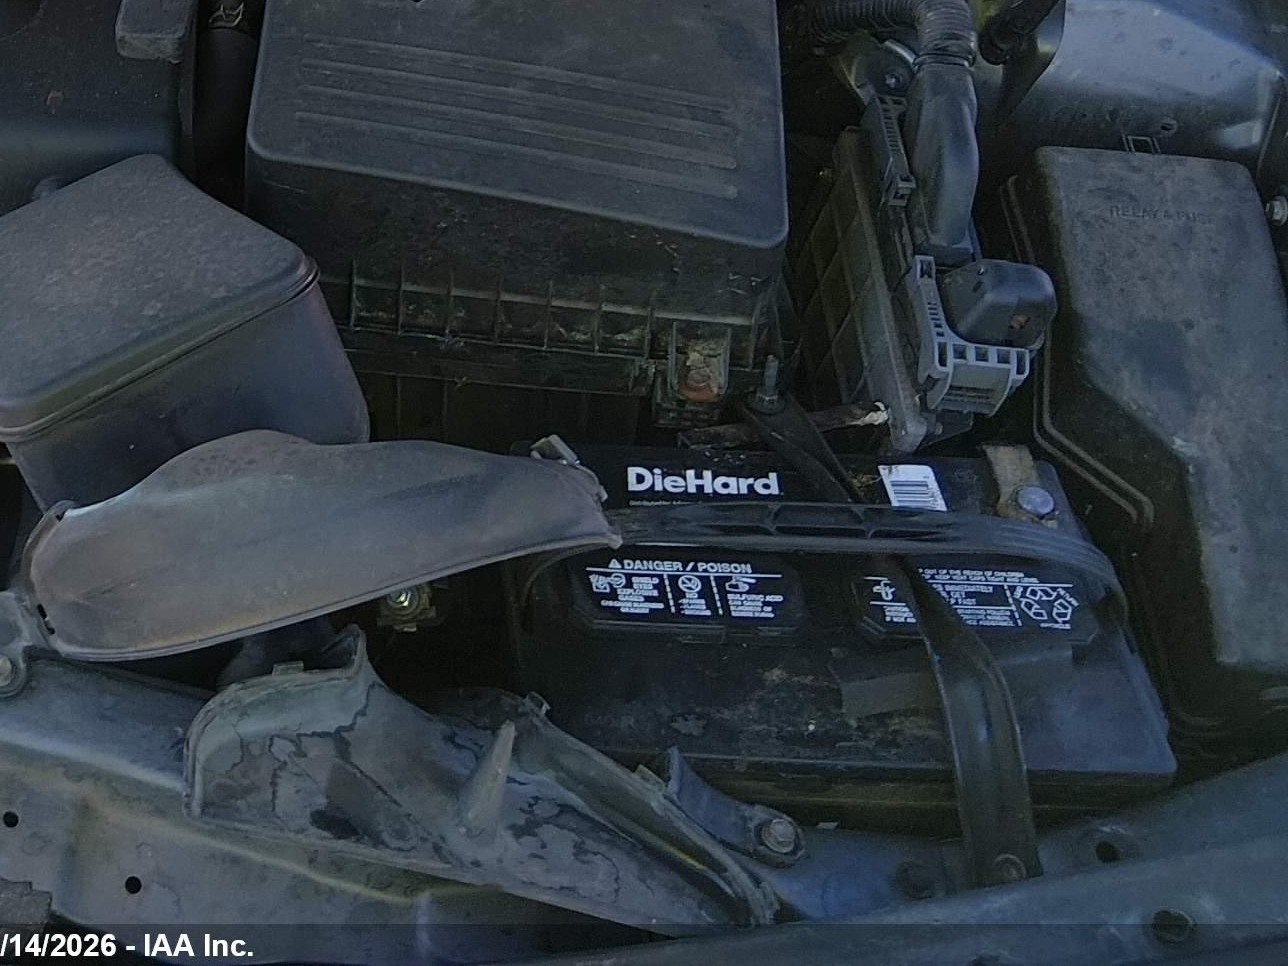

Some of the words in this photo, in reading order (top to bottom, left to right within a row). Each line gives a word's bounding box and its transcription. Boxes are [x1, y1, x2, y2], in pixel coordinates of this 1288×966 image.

[627, 466, 780, 495] DieHard
[623, 559, 683, 571] DANGER
[698, 563, 752, 574] POISON
